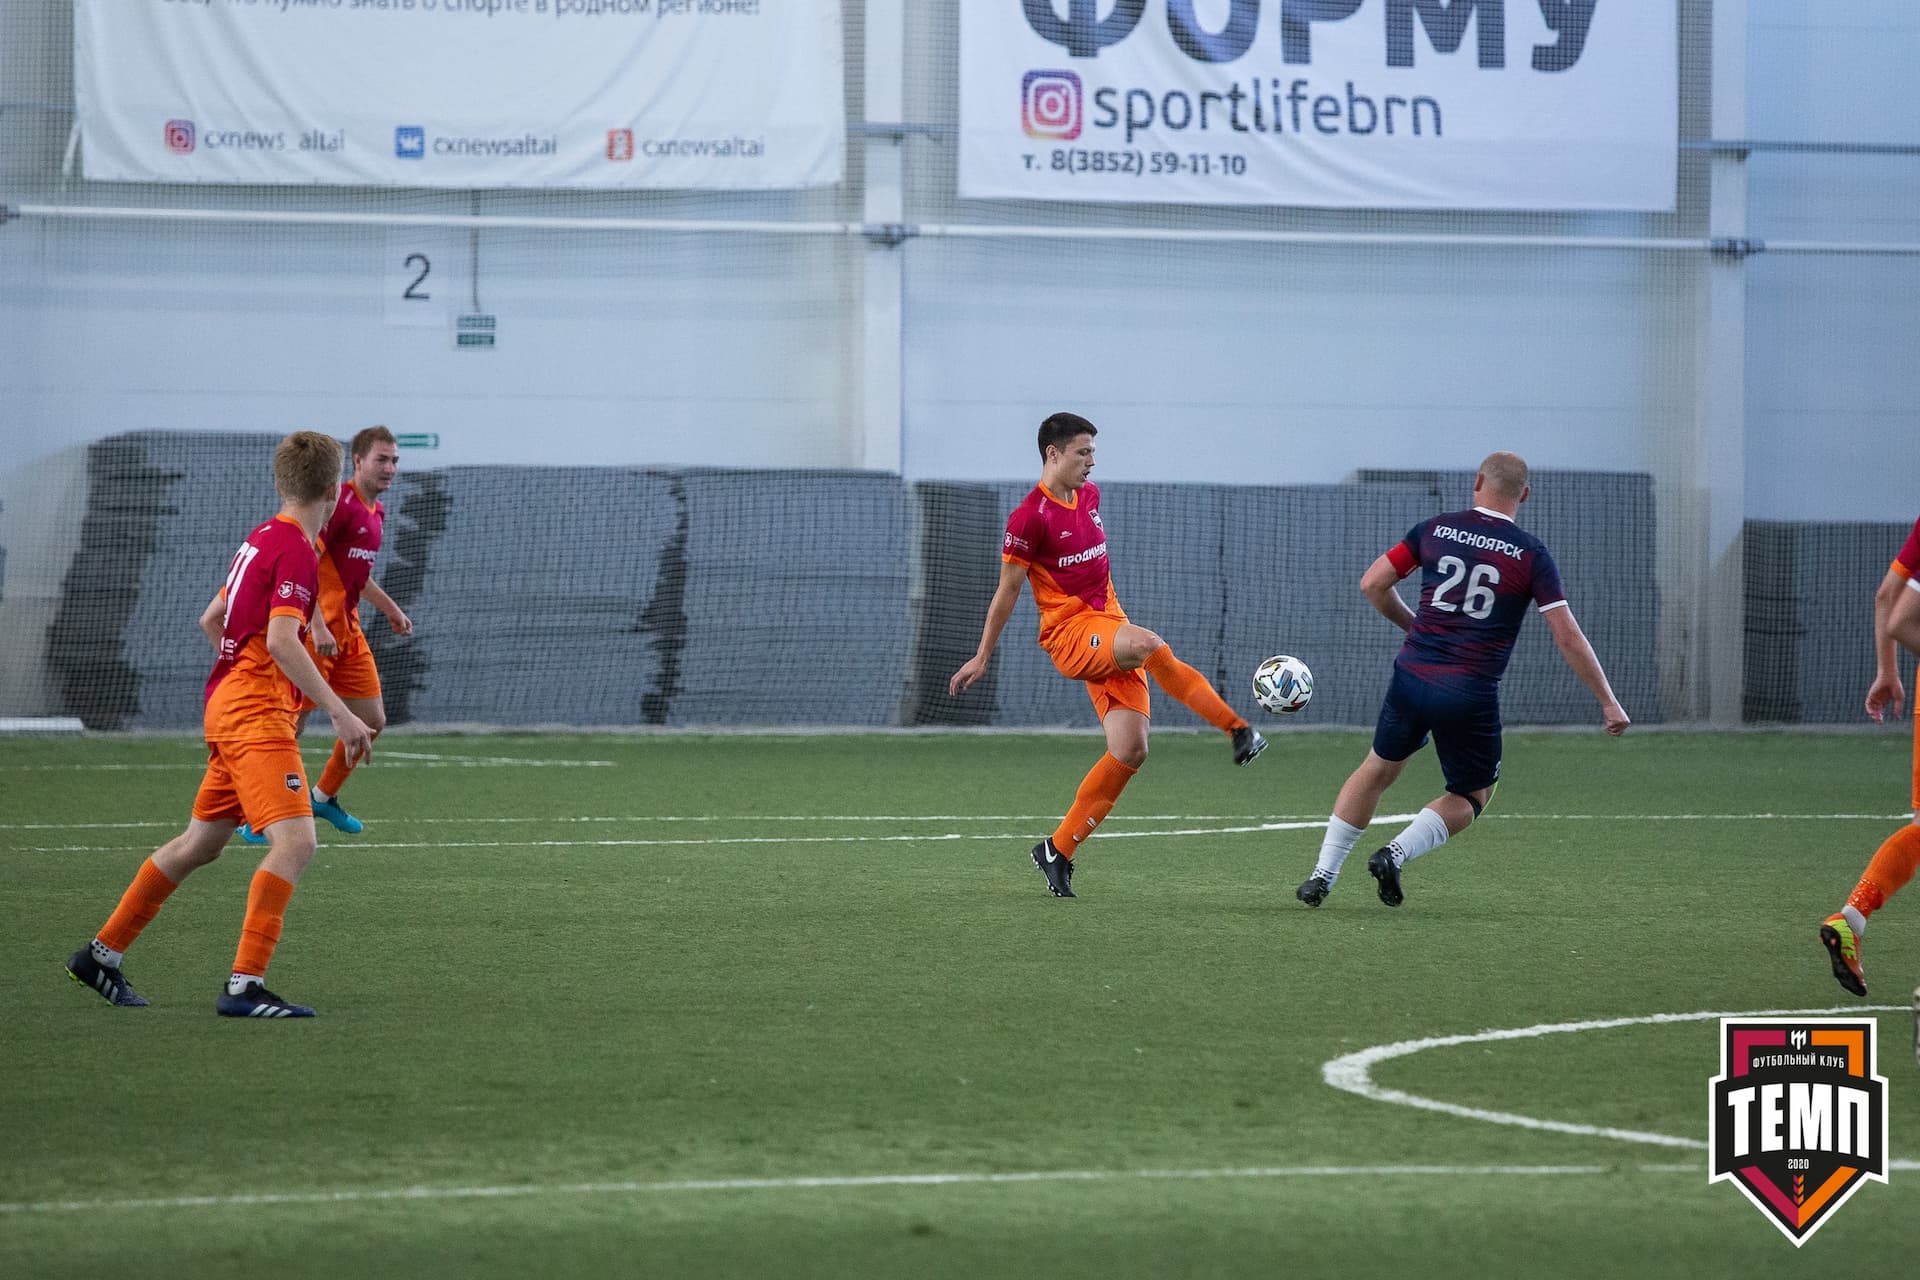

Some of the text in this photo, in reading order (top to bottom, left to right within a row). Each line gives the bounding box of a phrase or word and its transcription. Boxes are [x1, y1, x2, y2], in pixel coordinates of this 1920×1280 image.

[555, 0, 650, 17] родном
[1094, 77, 1442, 143] sportlifebrn
[433, 133, 557, 156] cxnewsaltai
[641, 135, 765, 157] cxnewsaltai
[1051, 149, 1144, 176] 8(3852)
[1150, 151, 1246, 175] 59-11-10
[403, 253, 431, 300] 2
[1433, 525, 1524, 560] КРАСНОЯРСК
[1431, 555, 1500, 620] 26
